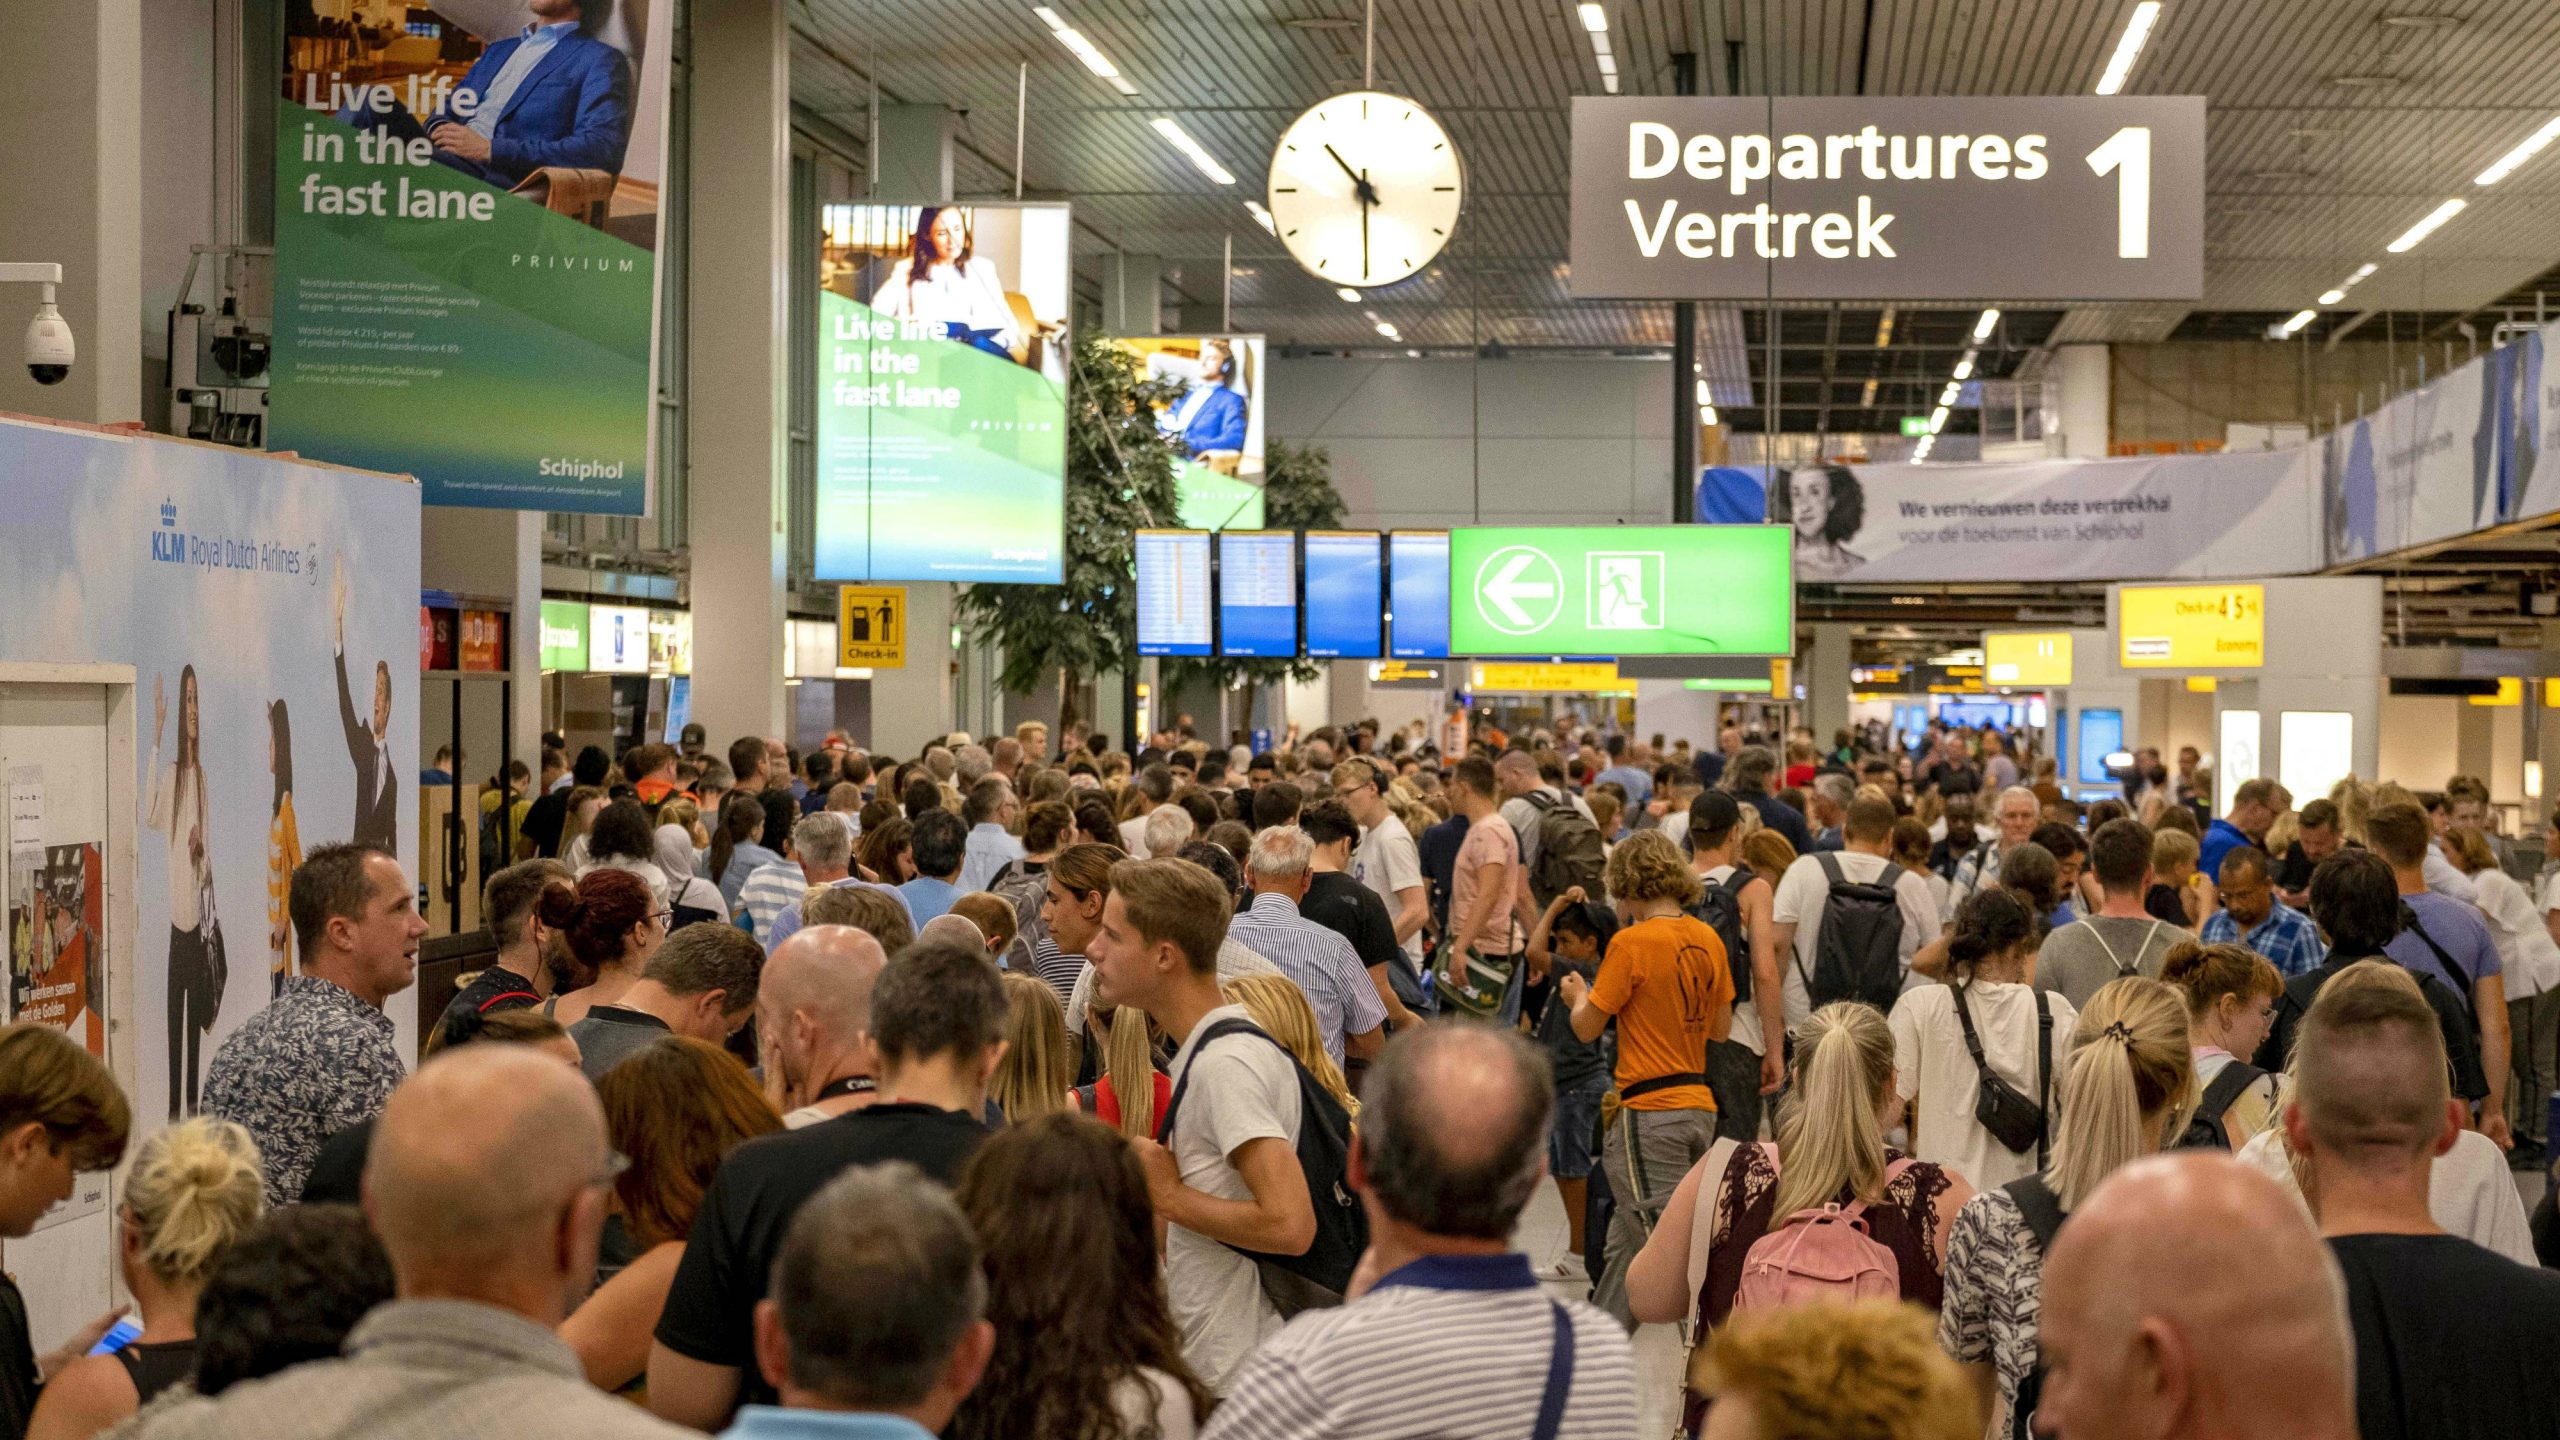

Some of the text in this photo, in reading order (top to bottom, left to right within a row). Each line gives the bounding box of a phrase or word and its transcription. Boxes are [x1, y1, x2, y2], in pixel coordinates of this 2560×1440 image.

[305, 72, 478, 117] Live life
[303, 123, 433, 167] in the
[1628, 121, 2049, 195] Departures
[300, 173, 495, 221] fast lane
[2085, 126, 2151, 260] 1
[1623, 195, 1898, 260] Vertrek
[512, 254, 633, 272] PRIVIUM
[834, 313, 949, 342] Live life
[834, 346, 920, 375] in the
[832, 379, 961, 409] fast lane
[539, 457, 623, 481] Schiphol
[1898, 501, 1927, 518] We
[1931, 499, 2036, 518] vernieuwen
[2040, 498, 2080, 515] deze
[152, 531, 301, 574] KLM Royal Dutch Airlines
[848, 648, 899, 659] Check-in
[18, 982, 76, 1006] Wij werken samen
[42, 1000, 66, 1018] Golden
